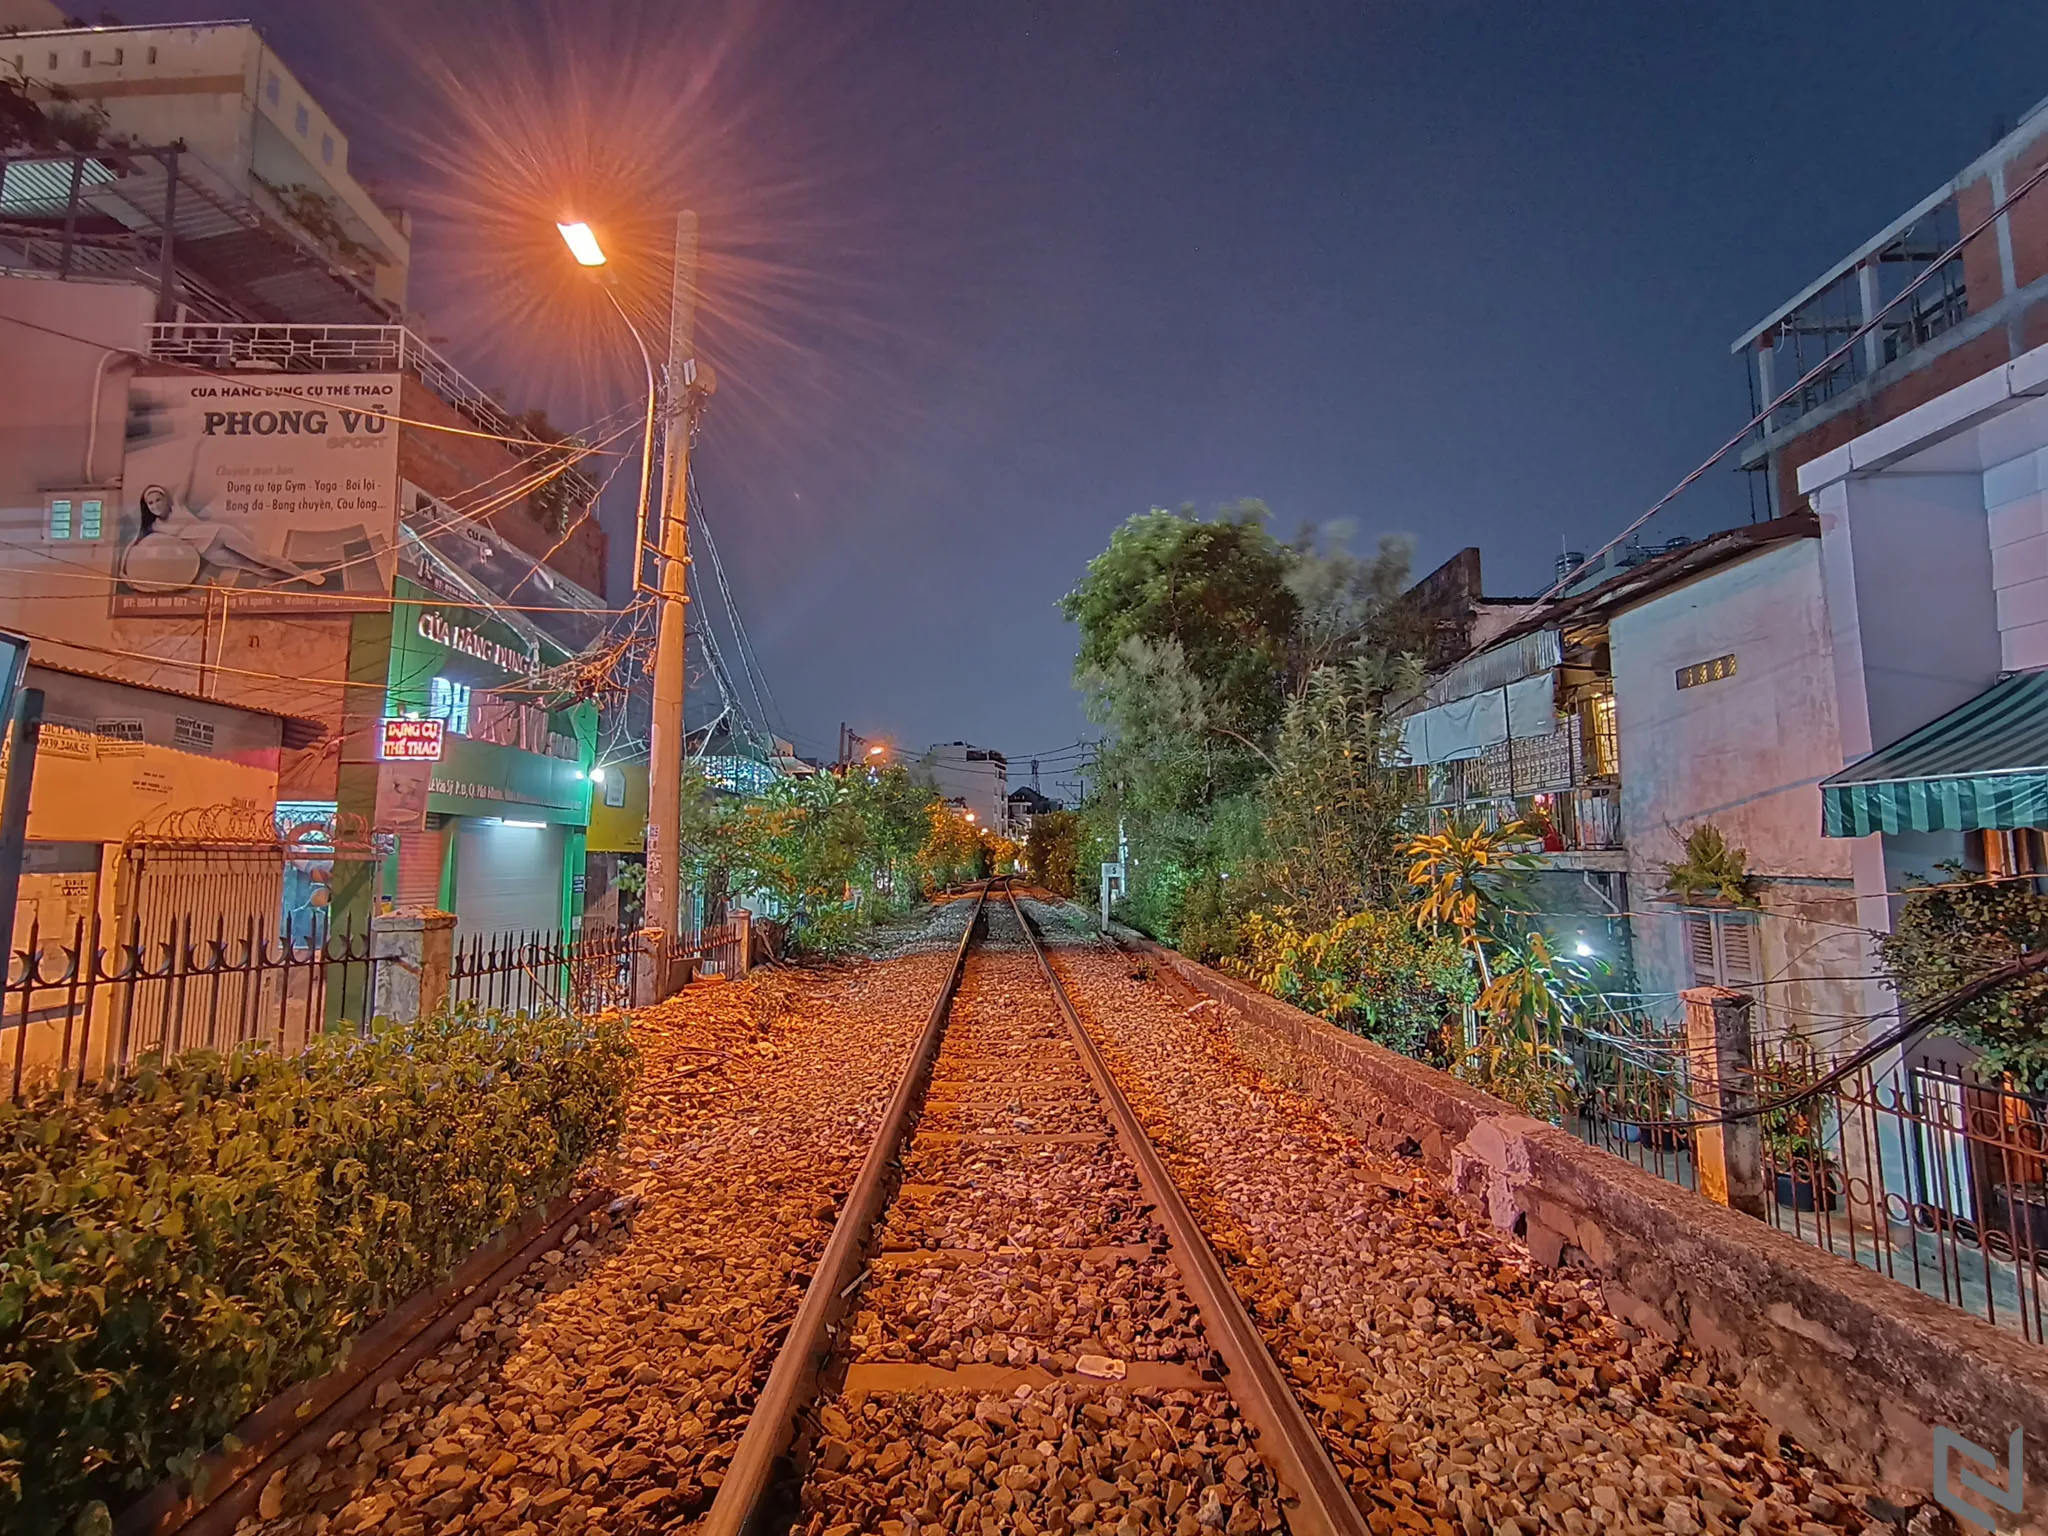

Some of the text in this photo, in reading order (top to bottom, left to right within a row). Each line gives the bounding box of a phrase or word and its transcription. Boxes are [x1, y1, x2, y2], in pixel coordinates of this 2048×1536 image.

[353, 385, 393, 396] THAO
[203, 403, 388, 436] PHONG VŨ
[285, 480, 306, 493] Gym
[315, 480, 337, 493] Yoga
[418, 611, 450, 646] CỬA
[452, 626, 493, 661] HÀNG
[388, 722, 438, 739] DỤNG CỤ
[407, 741, 438, 755] THAO
